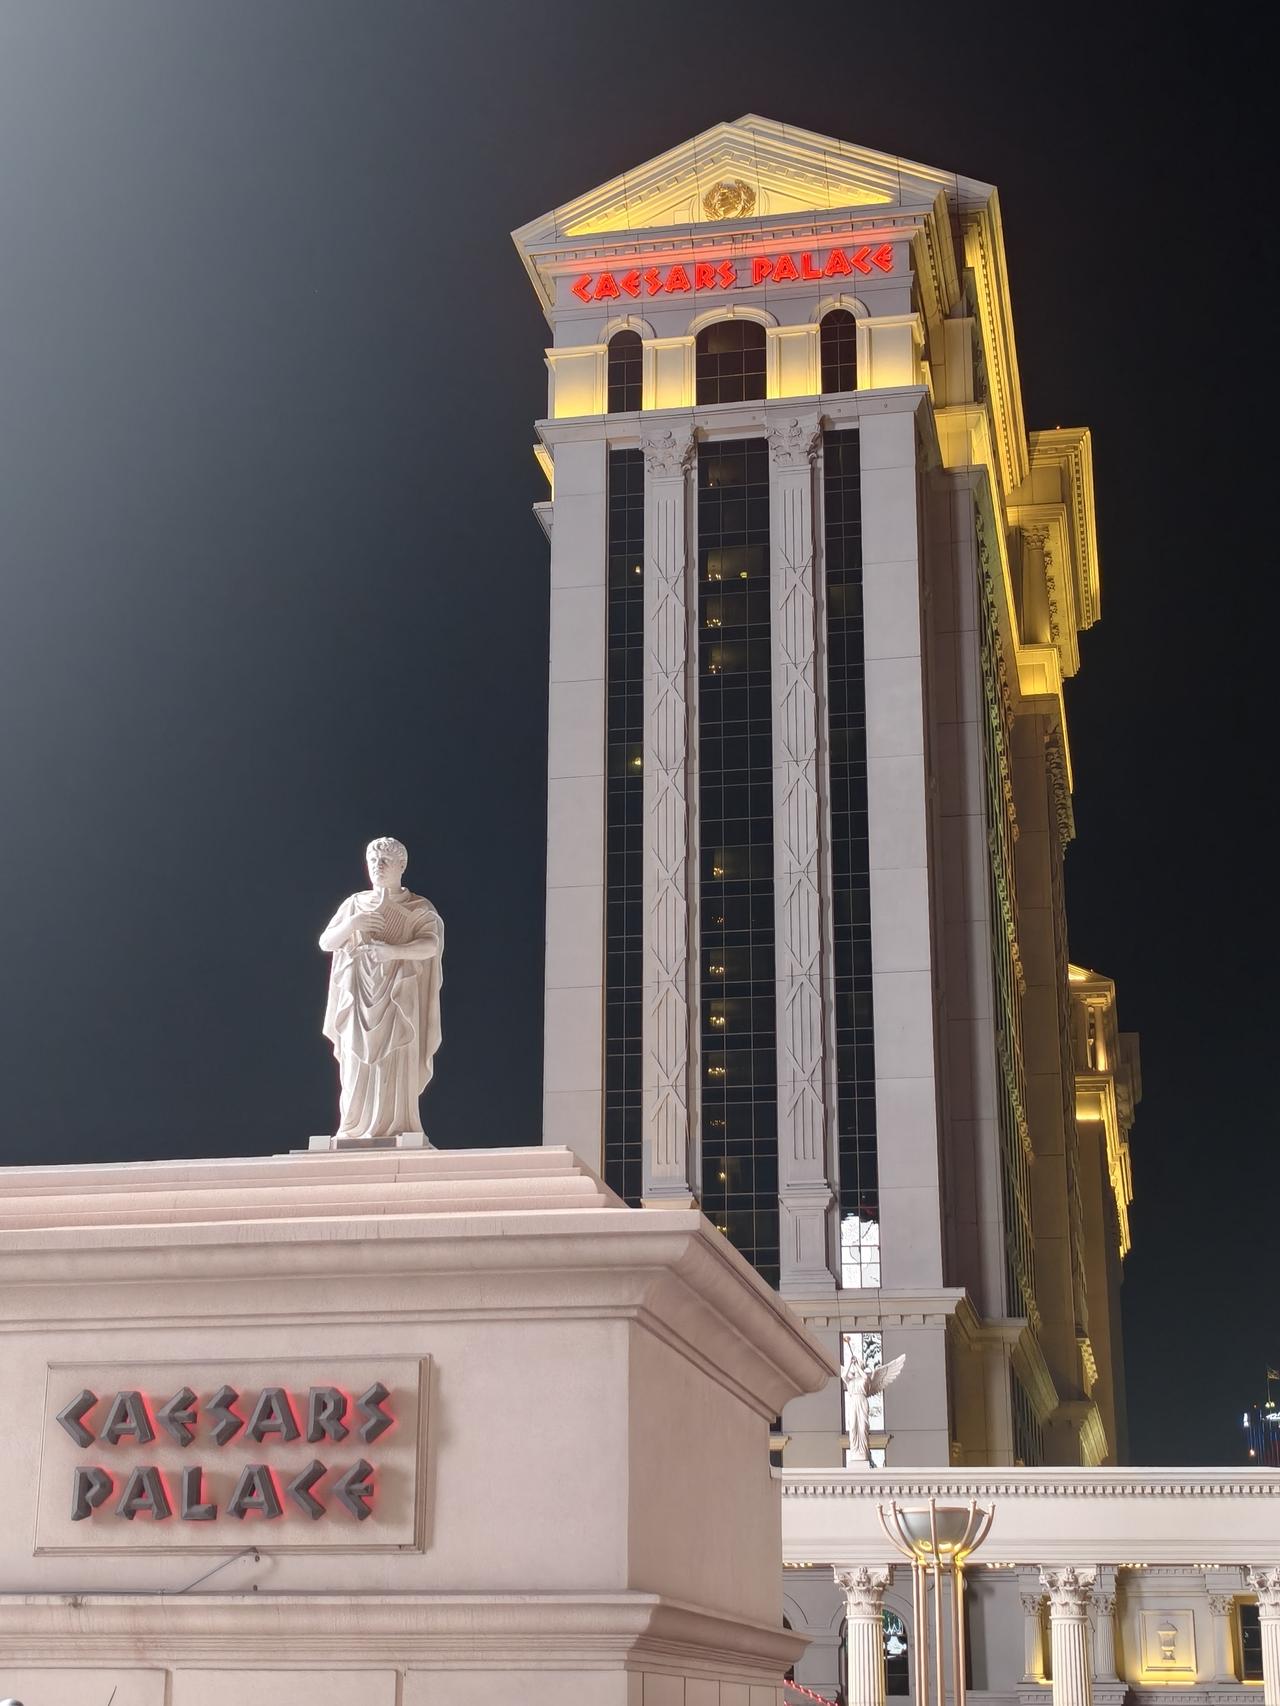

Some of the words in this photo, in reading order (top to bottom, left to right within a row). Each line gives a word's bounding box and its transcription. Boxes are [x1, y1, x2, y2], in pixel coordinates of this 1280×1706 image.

[571, 260, 736, 302] CAESARS
[753, 244, 893, 284] PALACE
[56, 1382, 394, 1448] CAESARS
[71, 1459, 374, 1521] PALACE
